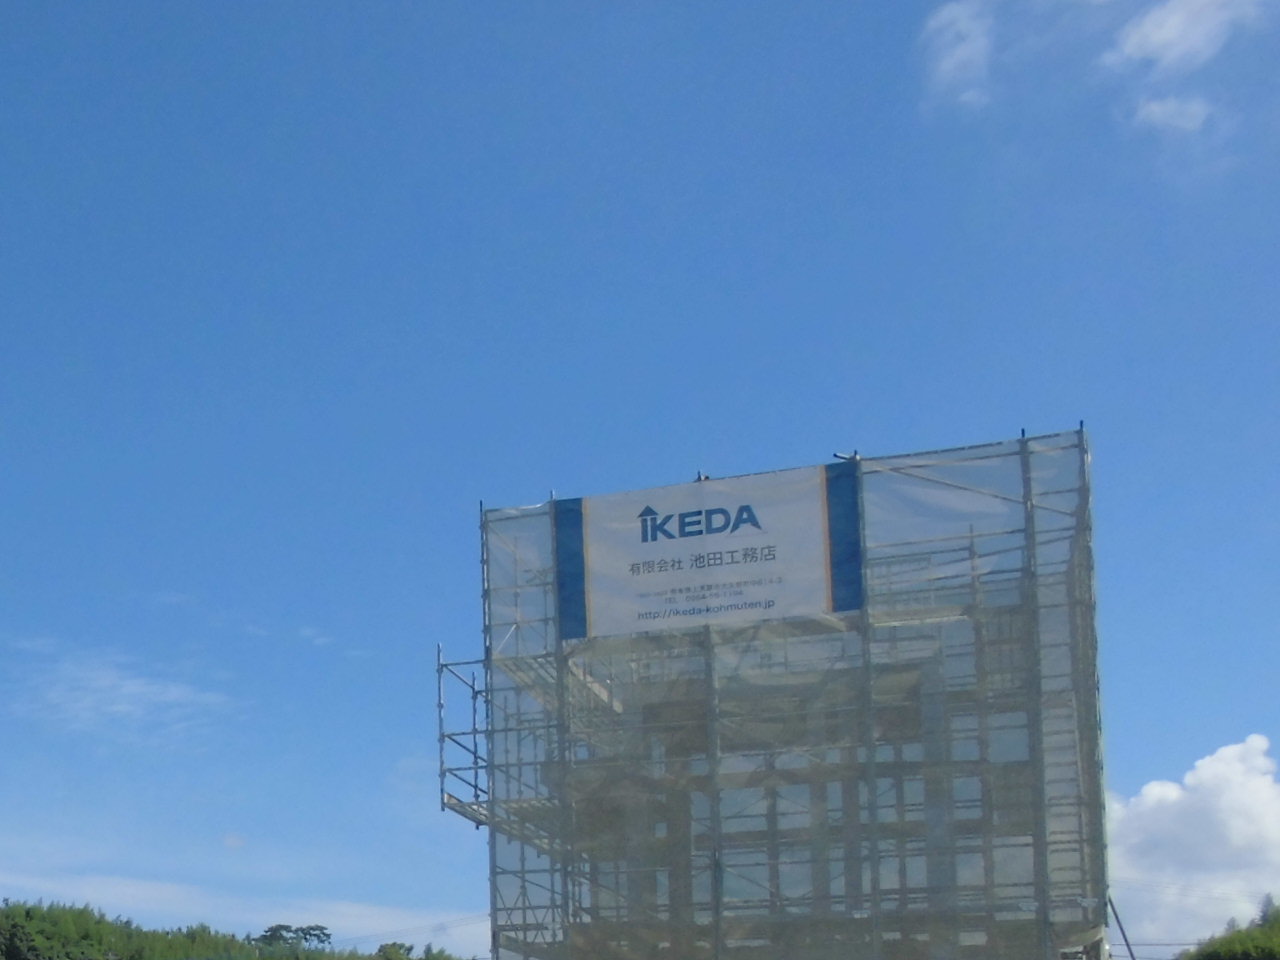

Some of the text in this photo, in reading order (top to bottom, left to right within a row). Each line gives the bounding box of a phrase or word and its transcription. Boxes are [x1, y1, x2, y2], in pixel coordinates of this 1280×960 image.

[637, 505, 762, 543] IKEDA
[627, 545, 777, 577] 有限会社 池田工務店
[637, 599, 776, 621] http://ikeda-kohmuten.jp
